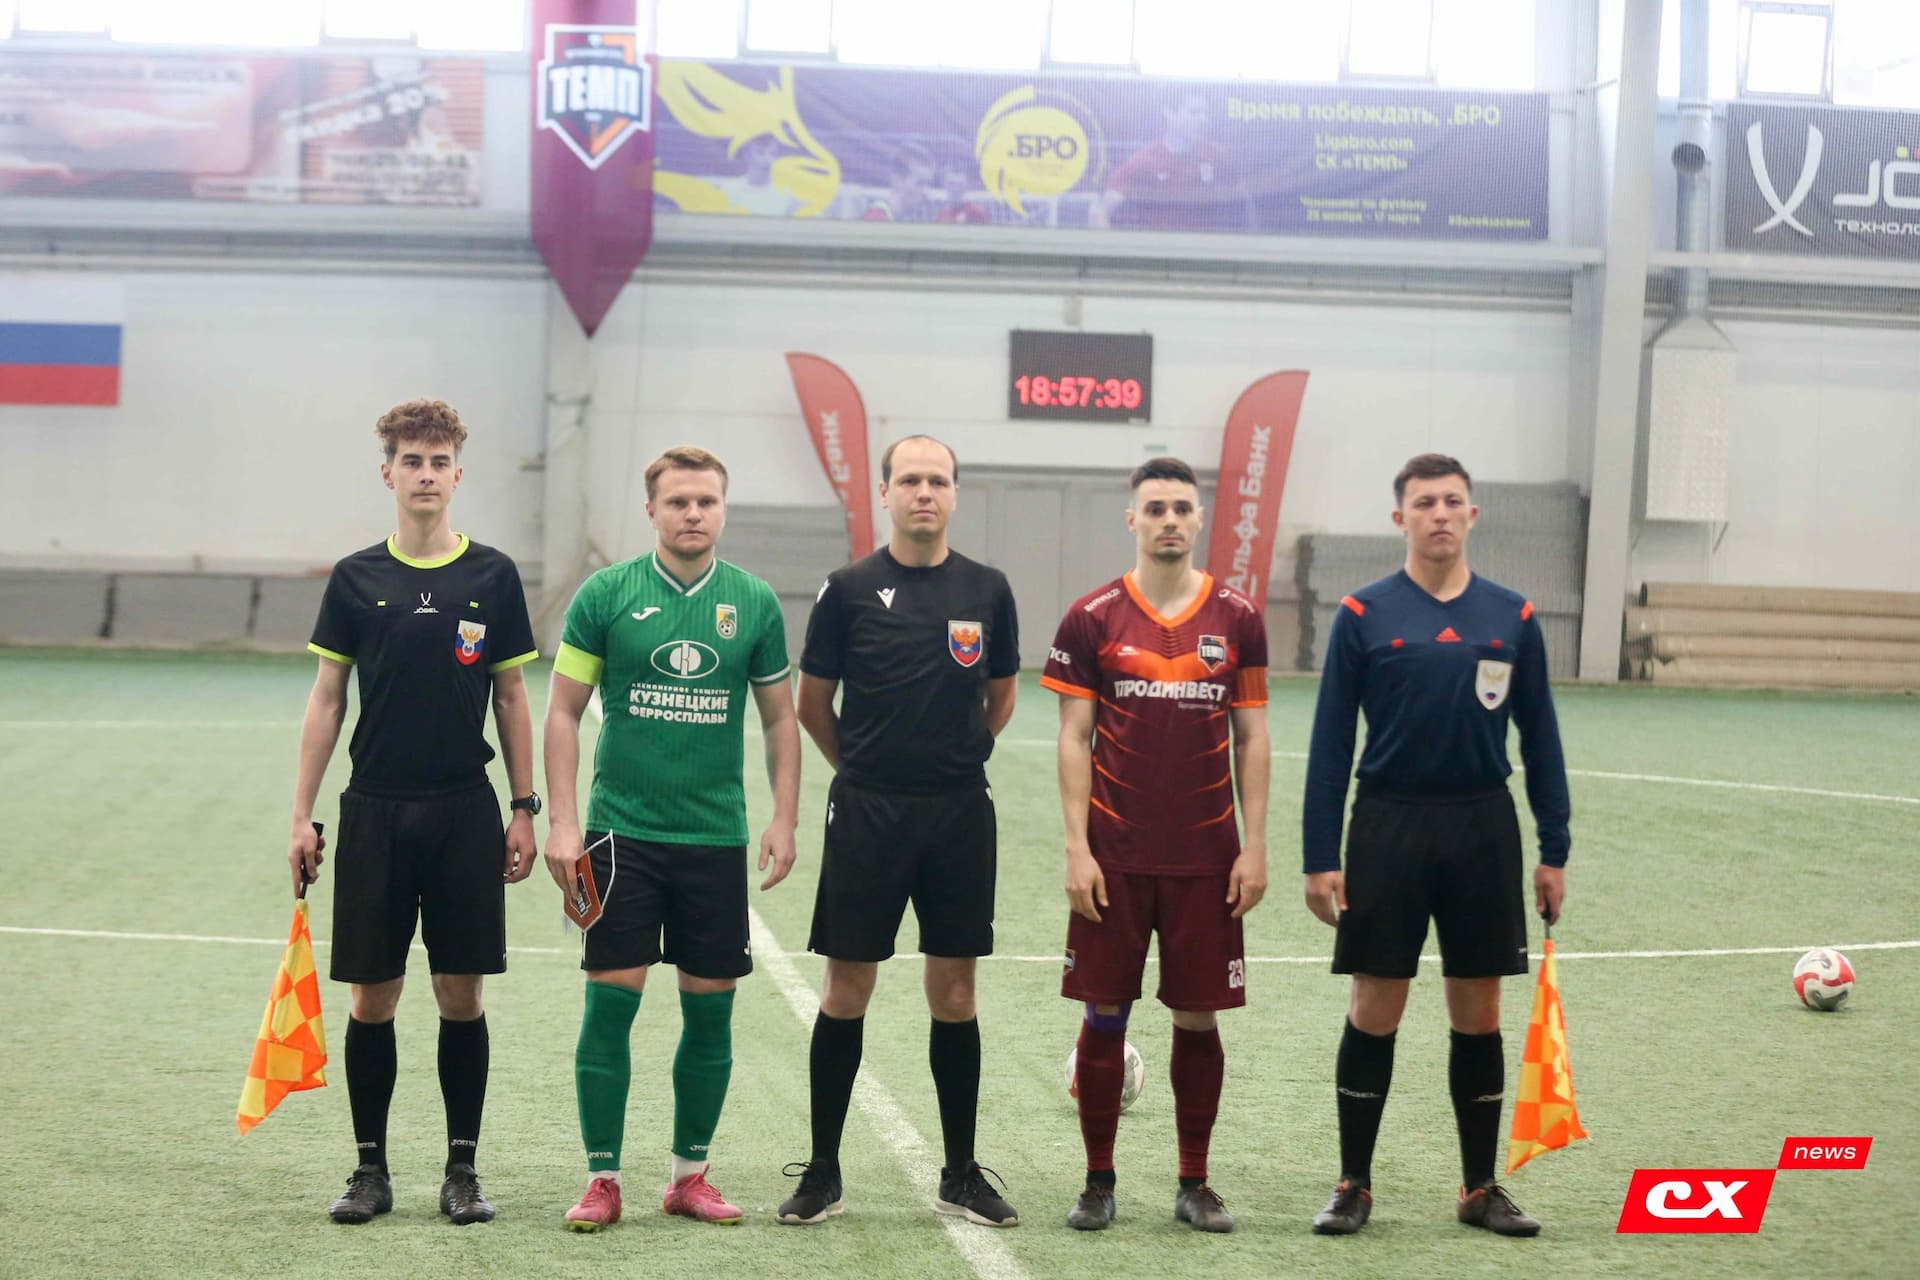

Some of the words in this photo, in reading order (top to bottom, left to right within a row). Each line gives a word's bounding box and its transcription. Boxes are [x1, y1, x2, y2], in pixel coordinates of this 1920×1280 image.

[549, 64, 640, 116] ТЕМП
[1228, 97, 1300, 121] Время
[1308, 101, 1439, 126] побеждать,
[1008, 135, 1077, 159] .БРО
[1315, 153, 1337, 169] СК
[1343, 154, 1408, 170] «ТЕМП»
[1015, 375, 1141, 409] 18:57:39
[1239, 424, 1271, 498] Банк
[1225, 503, 1260, 596] Альфа
[630, 689, 729, 711] КУЗНЕЦКИЕ
[1115, 680, 1226, 701] ПРОДИНВЕСТ
[629, 705, 727, 723] ФЕРРОСПЛАВЫ
[1228, 959, 1244, 989] 23
